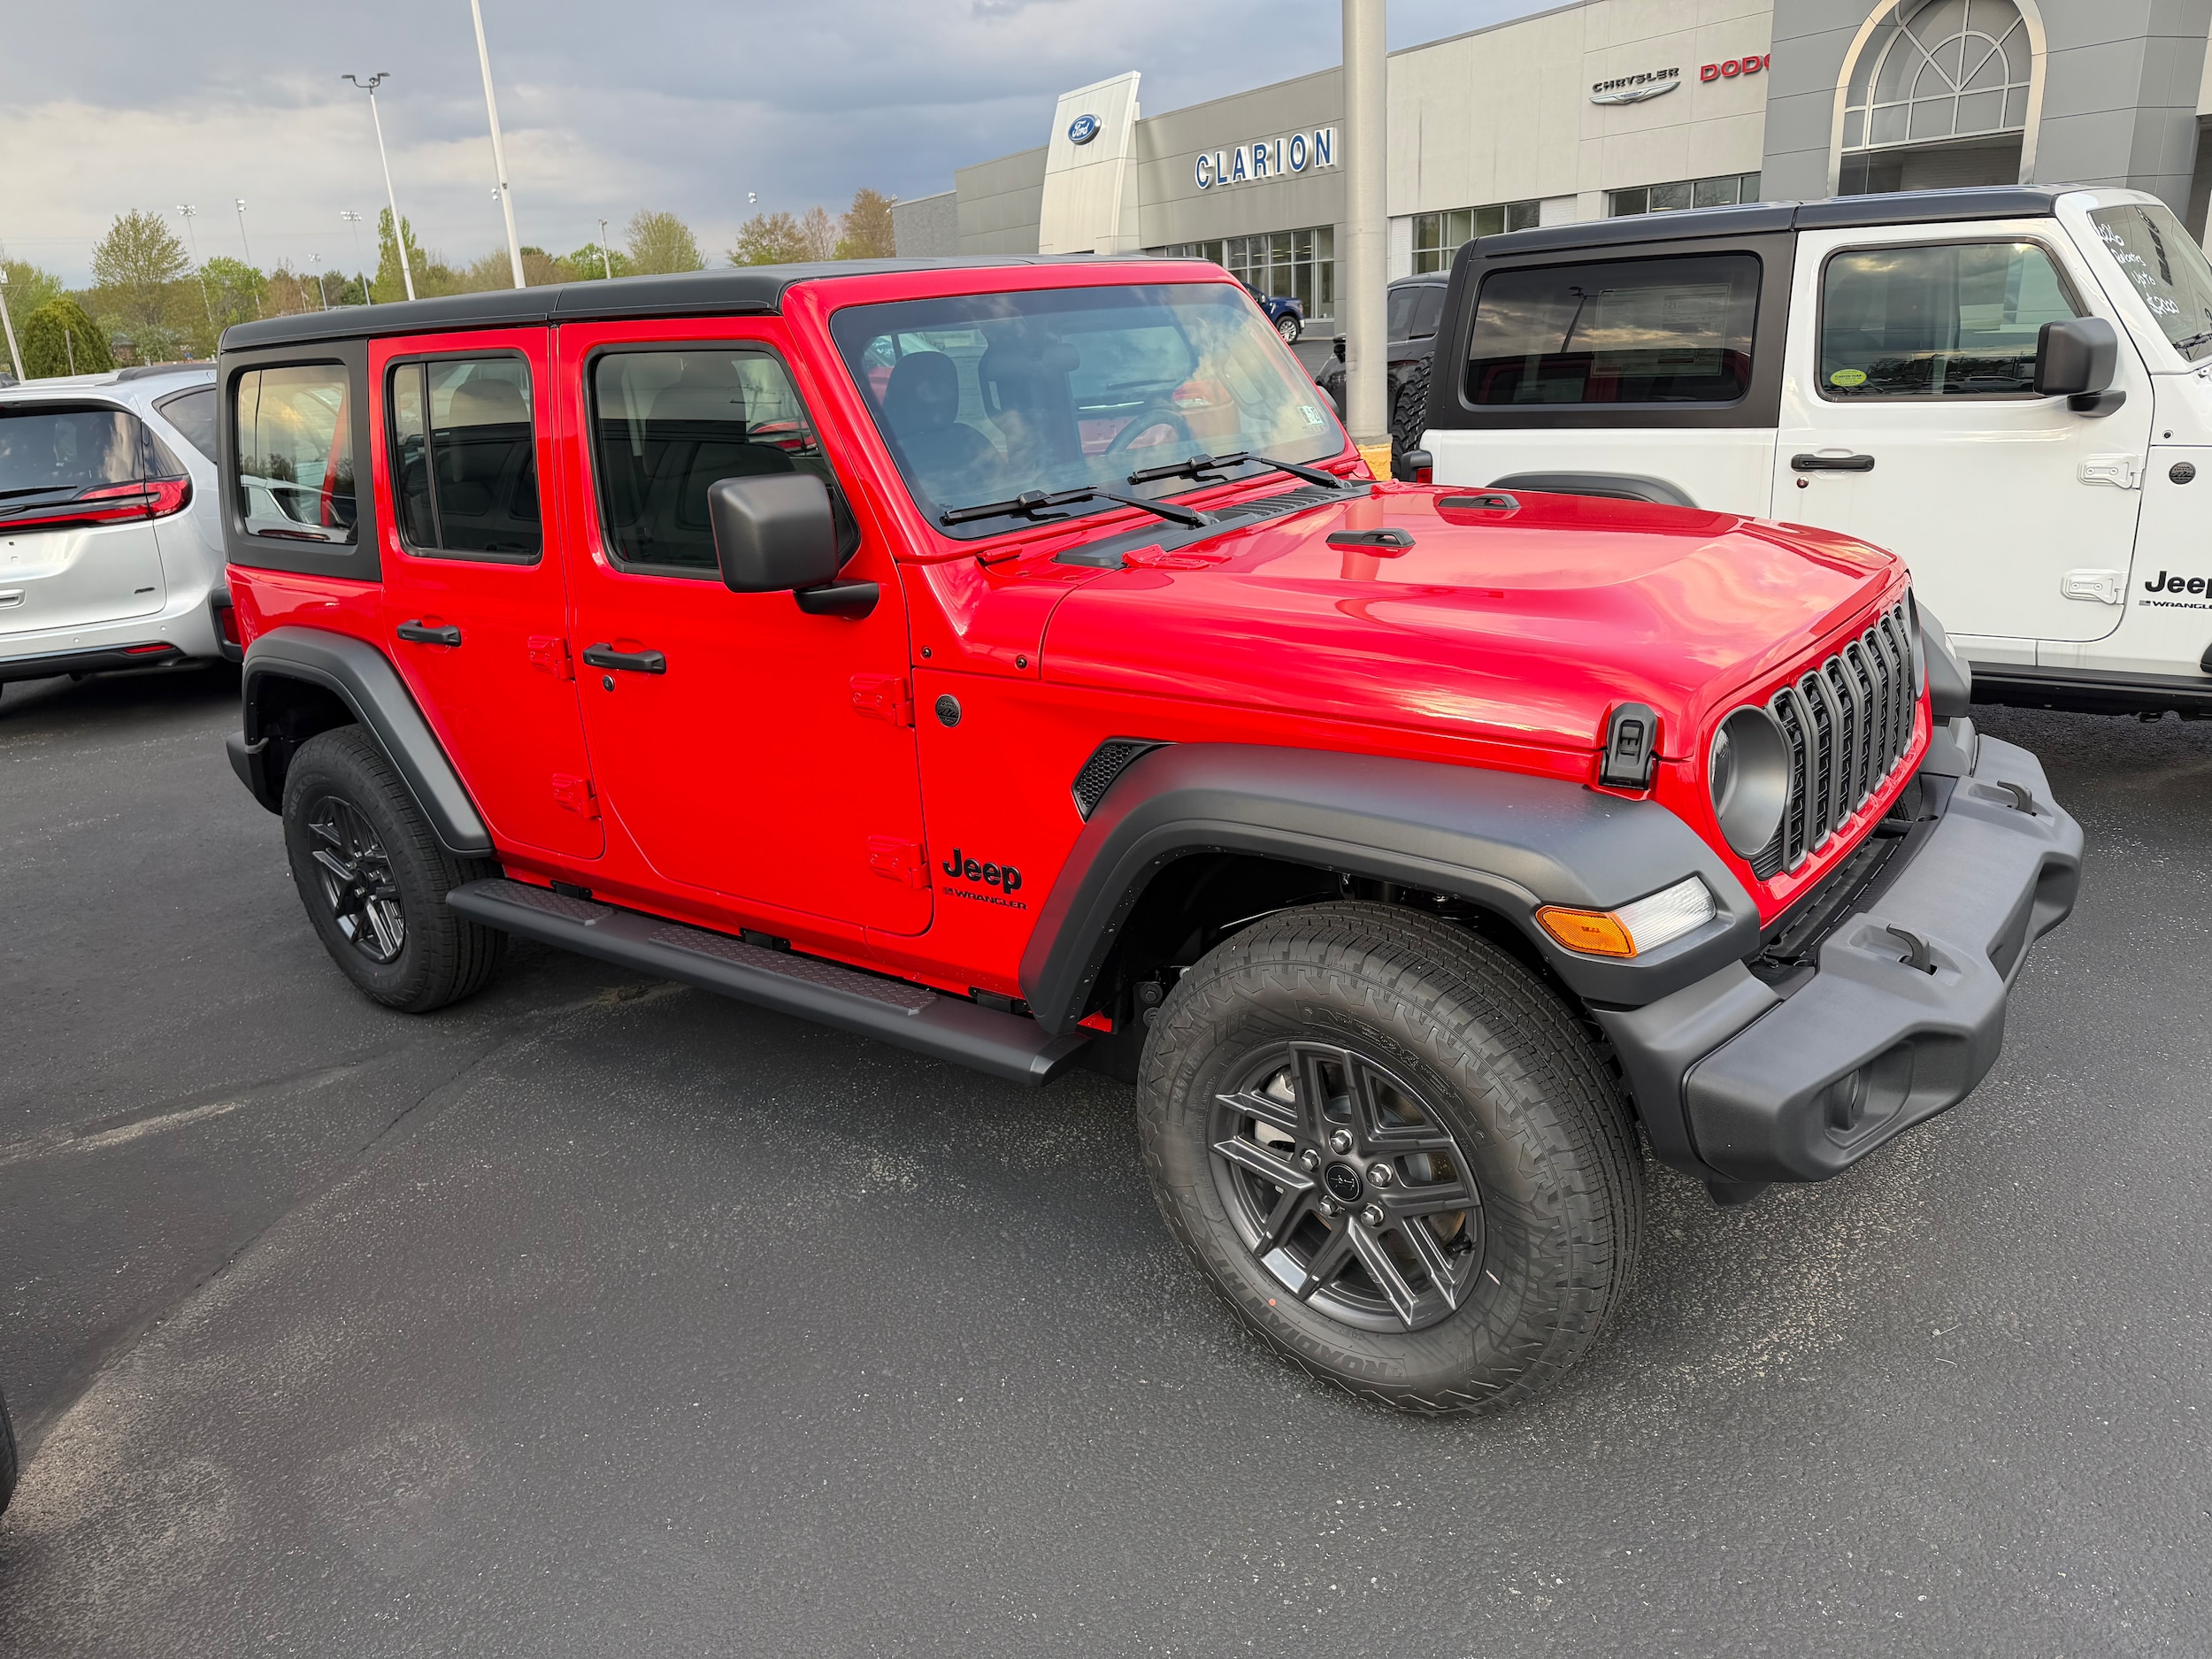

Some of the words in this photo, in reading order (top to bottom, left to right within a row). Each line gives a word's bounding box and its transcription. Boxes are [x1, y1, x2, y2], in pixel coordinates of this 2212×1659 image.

[1593, 67, 1680, 92] CHRYSLER
[1071, 120, 1090, 137] Ford
[1194, 127, 1337, 189] CLARION
[942, 848, 1022, 895] Jeep
[955, 889, 1028, 910] WRANGLER
